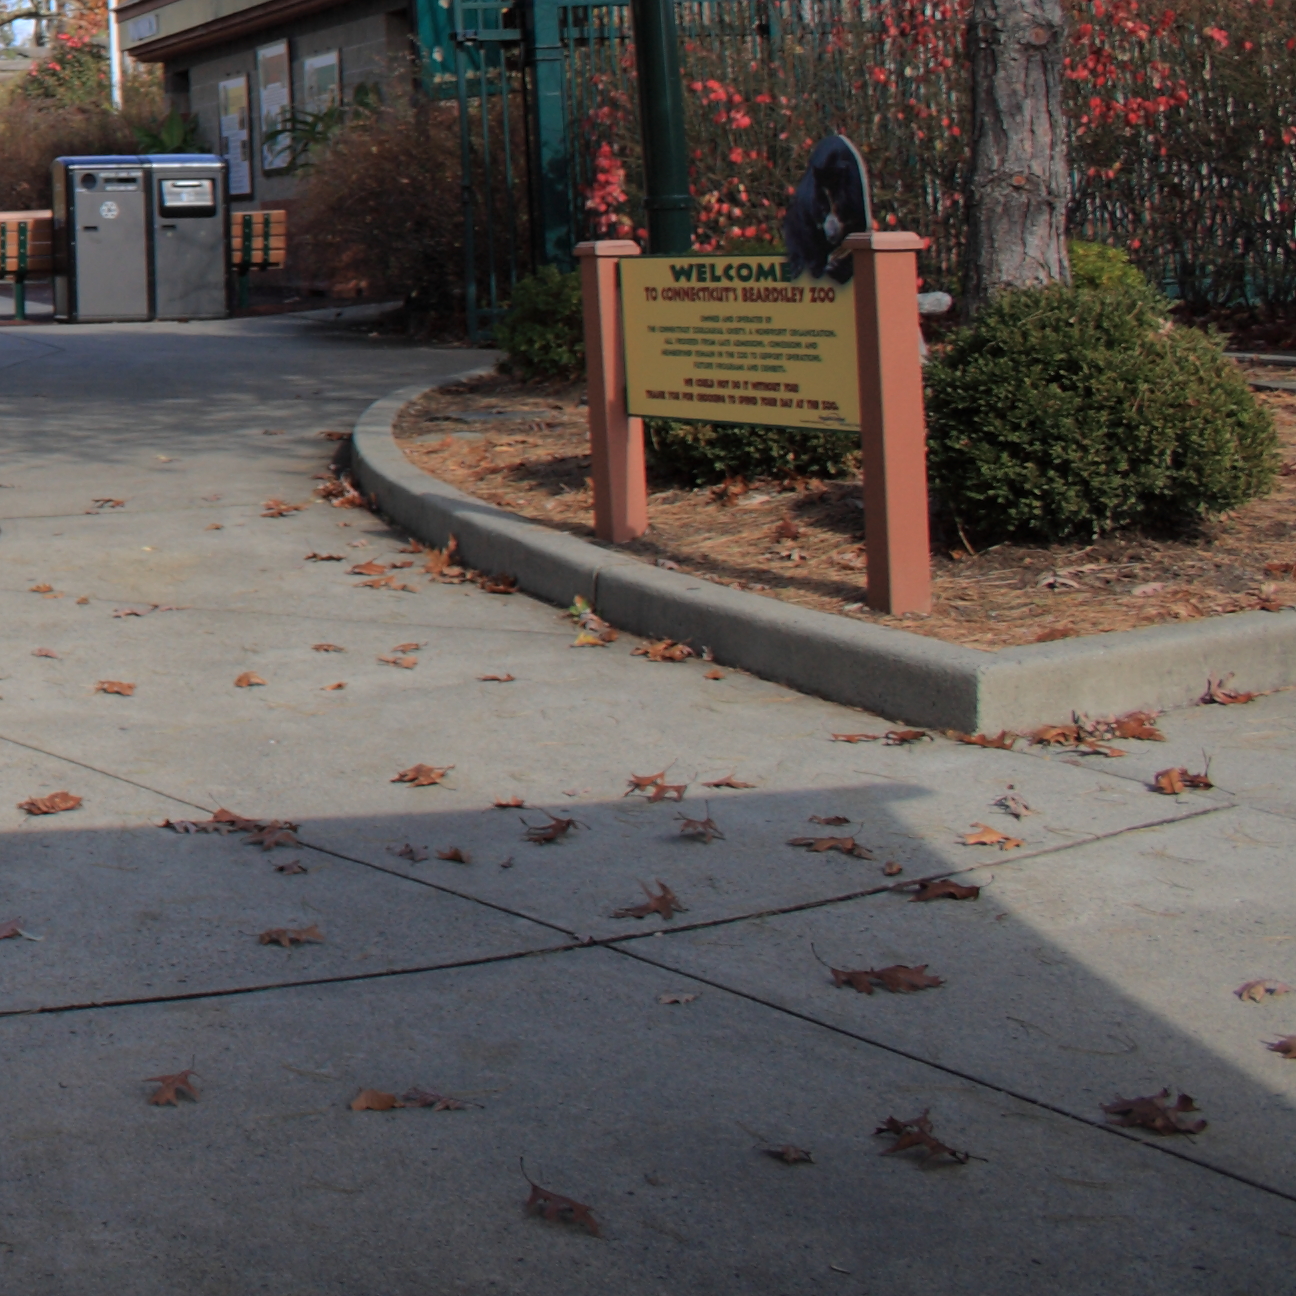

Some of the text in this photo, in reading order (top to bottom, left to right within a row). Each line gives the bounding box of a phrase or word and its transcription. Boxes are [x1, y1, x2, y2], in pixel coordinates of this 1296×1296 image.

[669, 263, 792, 282] WELCOME
[645, 286, 835, 303] TO CONNECTICUT'S BEARDSLEY ZOO
